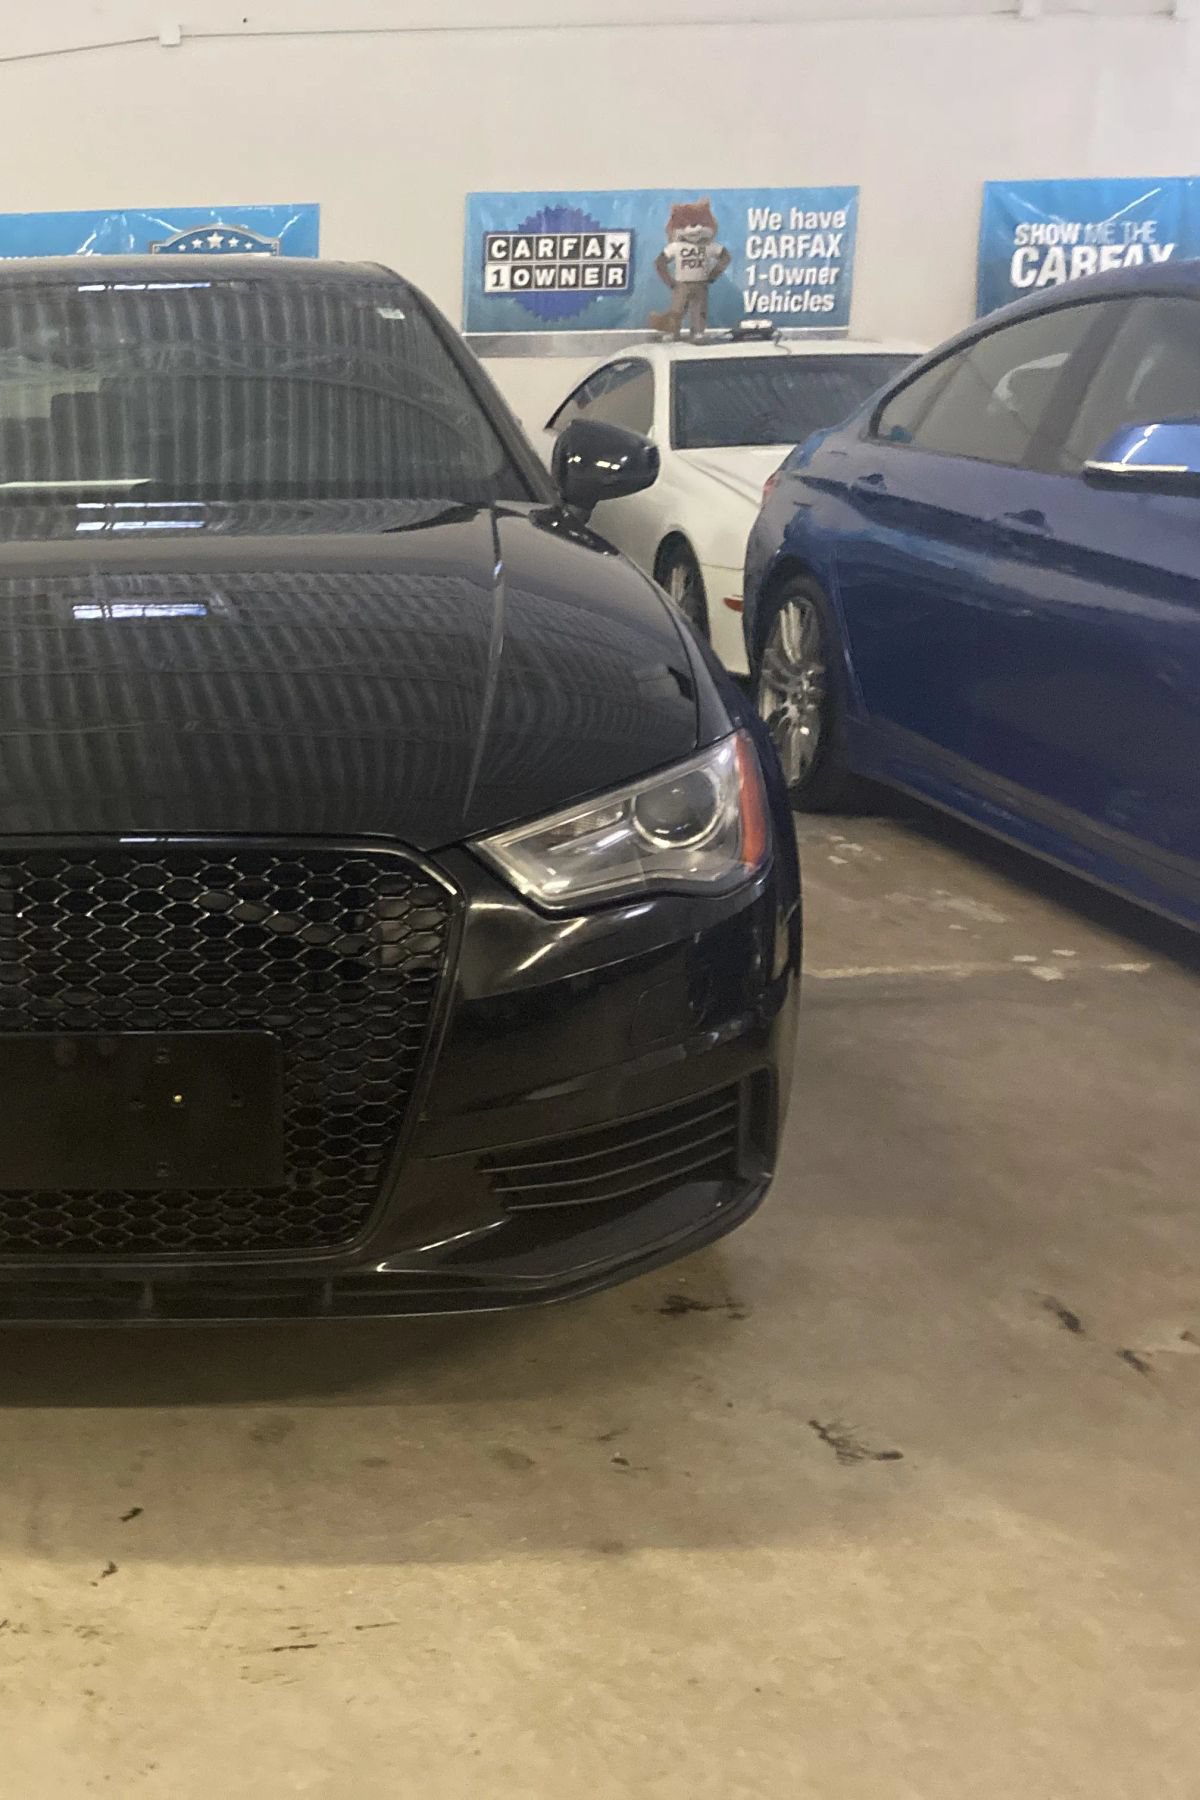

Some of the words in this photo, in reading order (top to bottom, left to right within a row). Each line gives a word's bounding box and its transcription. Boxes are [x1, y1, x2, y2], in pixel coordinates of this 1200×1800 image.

[748, 208, 787, 231] We
[791, 206, 847, 229] have
[1013, 223, 1080, 245] SHOW
[1084, 222, 1115, 245] ME
[1122, 220, 1158, 244] THE
[490, 237, 625, 260] CARFAX
[680, 247, 706, 258] CAR
[746, 234, 842, 259] CARFAX
[681, 258, 705, 269] FOX
[746, 263, 840, 286] 1-Owner
[743, 289, 836, 314] Vehicles
